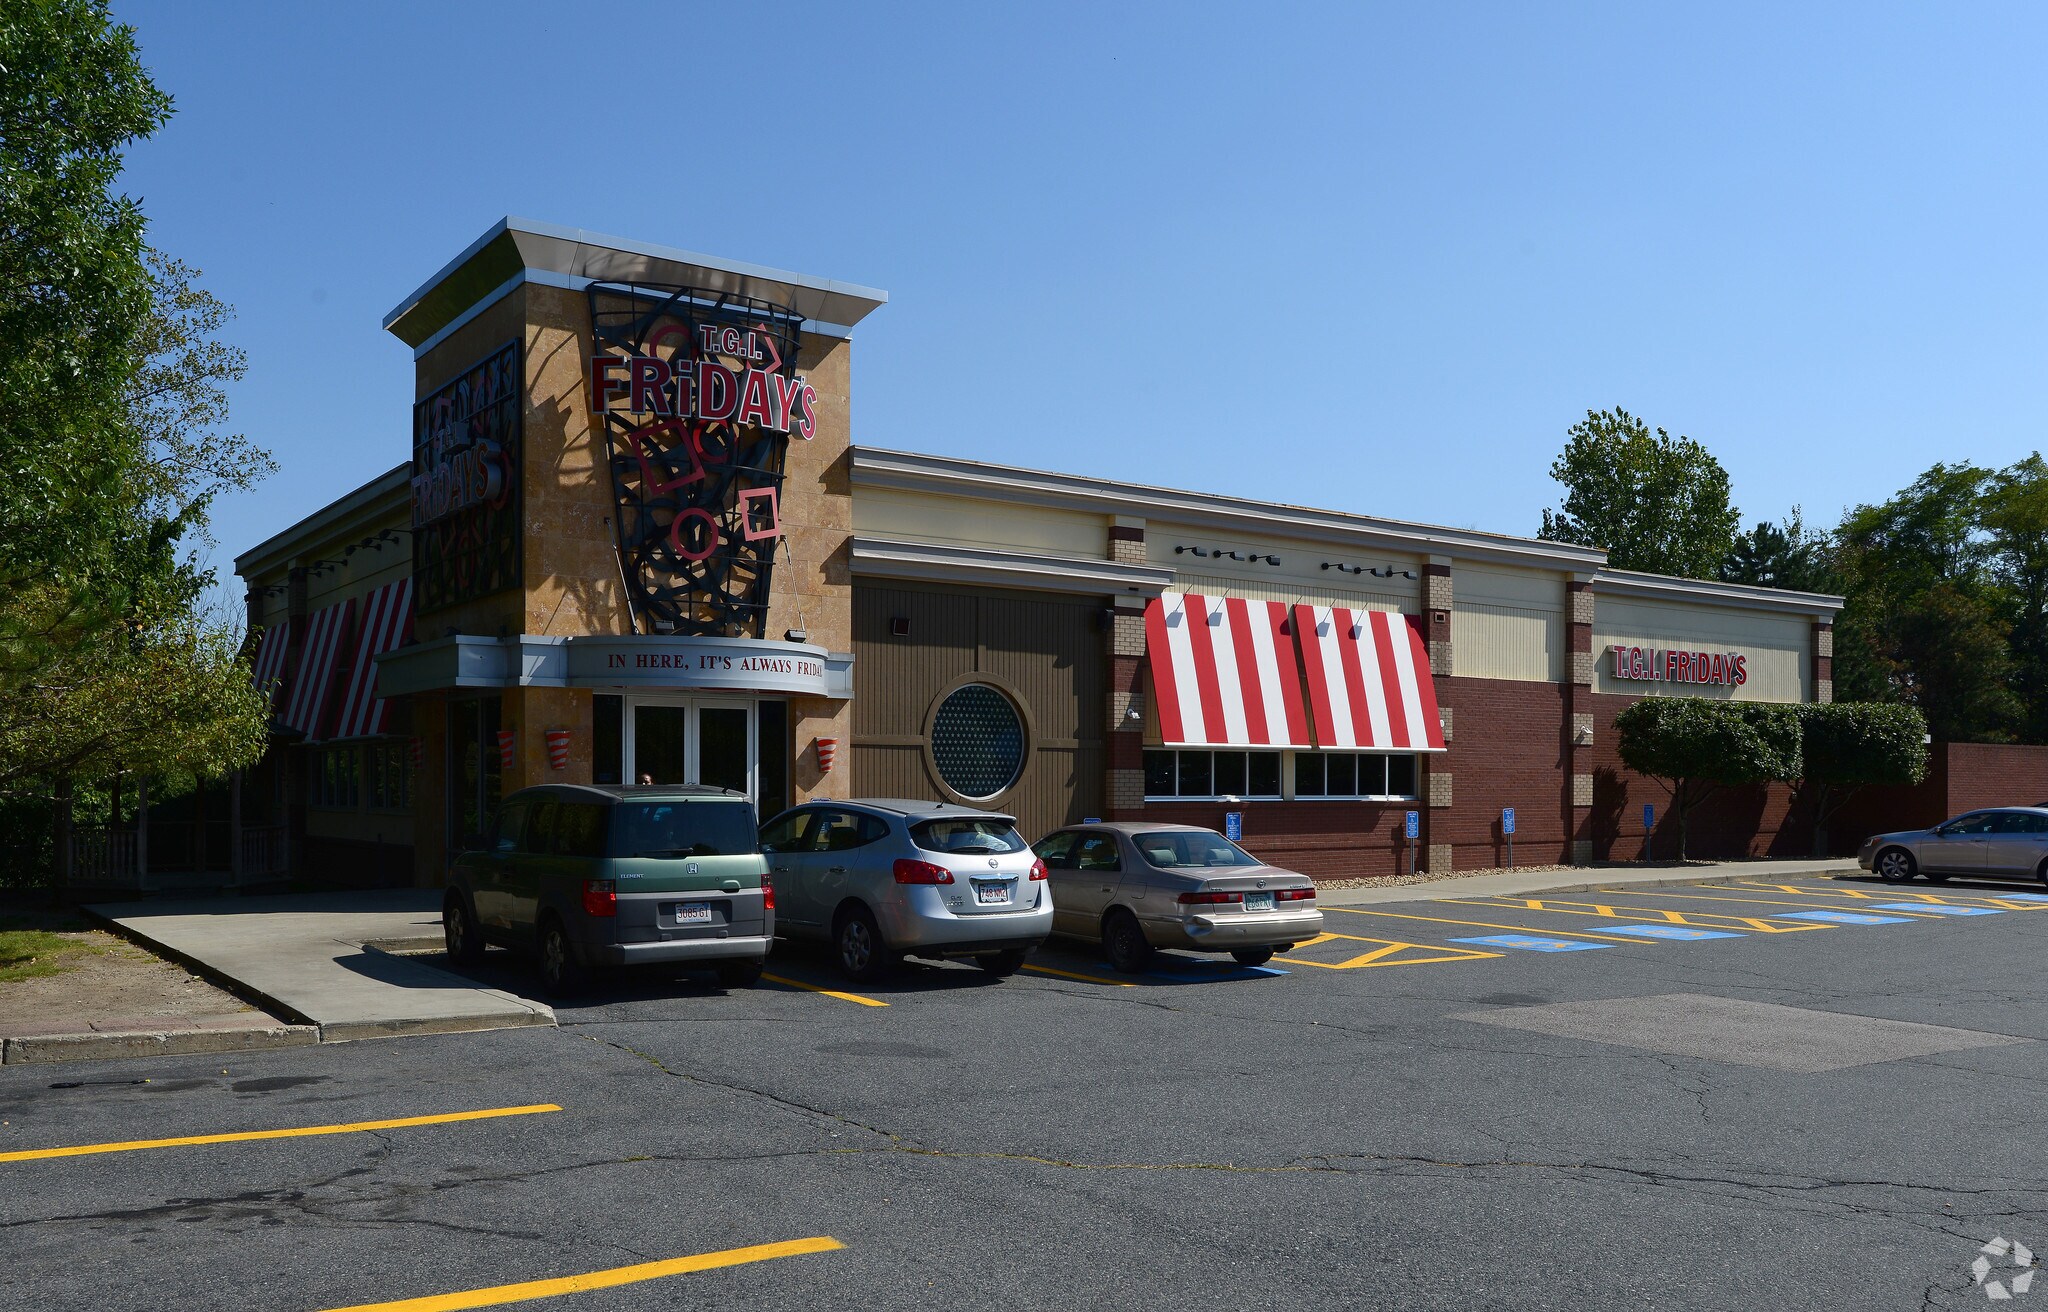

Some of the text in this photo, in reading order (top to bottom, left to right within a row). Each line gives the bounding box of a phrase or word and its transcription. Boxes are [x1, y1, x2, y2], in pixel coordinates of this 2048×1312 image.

[700, 325, 762, 360] T.G.I.
[608, 654, 626, 668] IN
[636, 654, 689, 670] HERE,
[700, 655, 731, 670] IT'S
[740, 657, 792, 673] ALWAYS
[1613, 645, 1660, 680] T.G.I.
